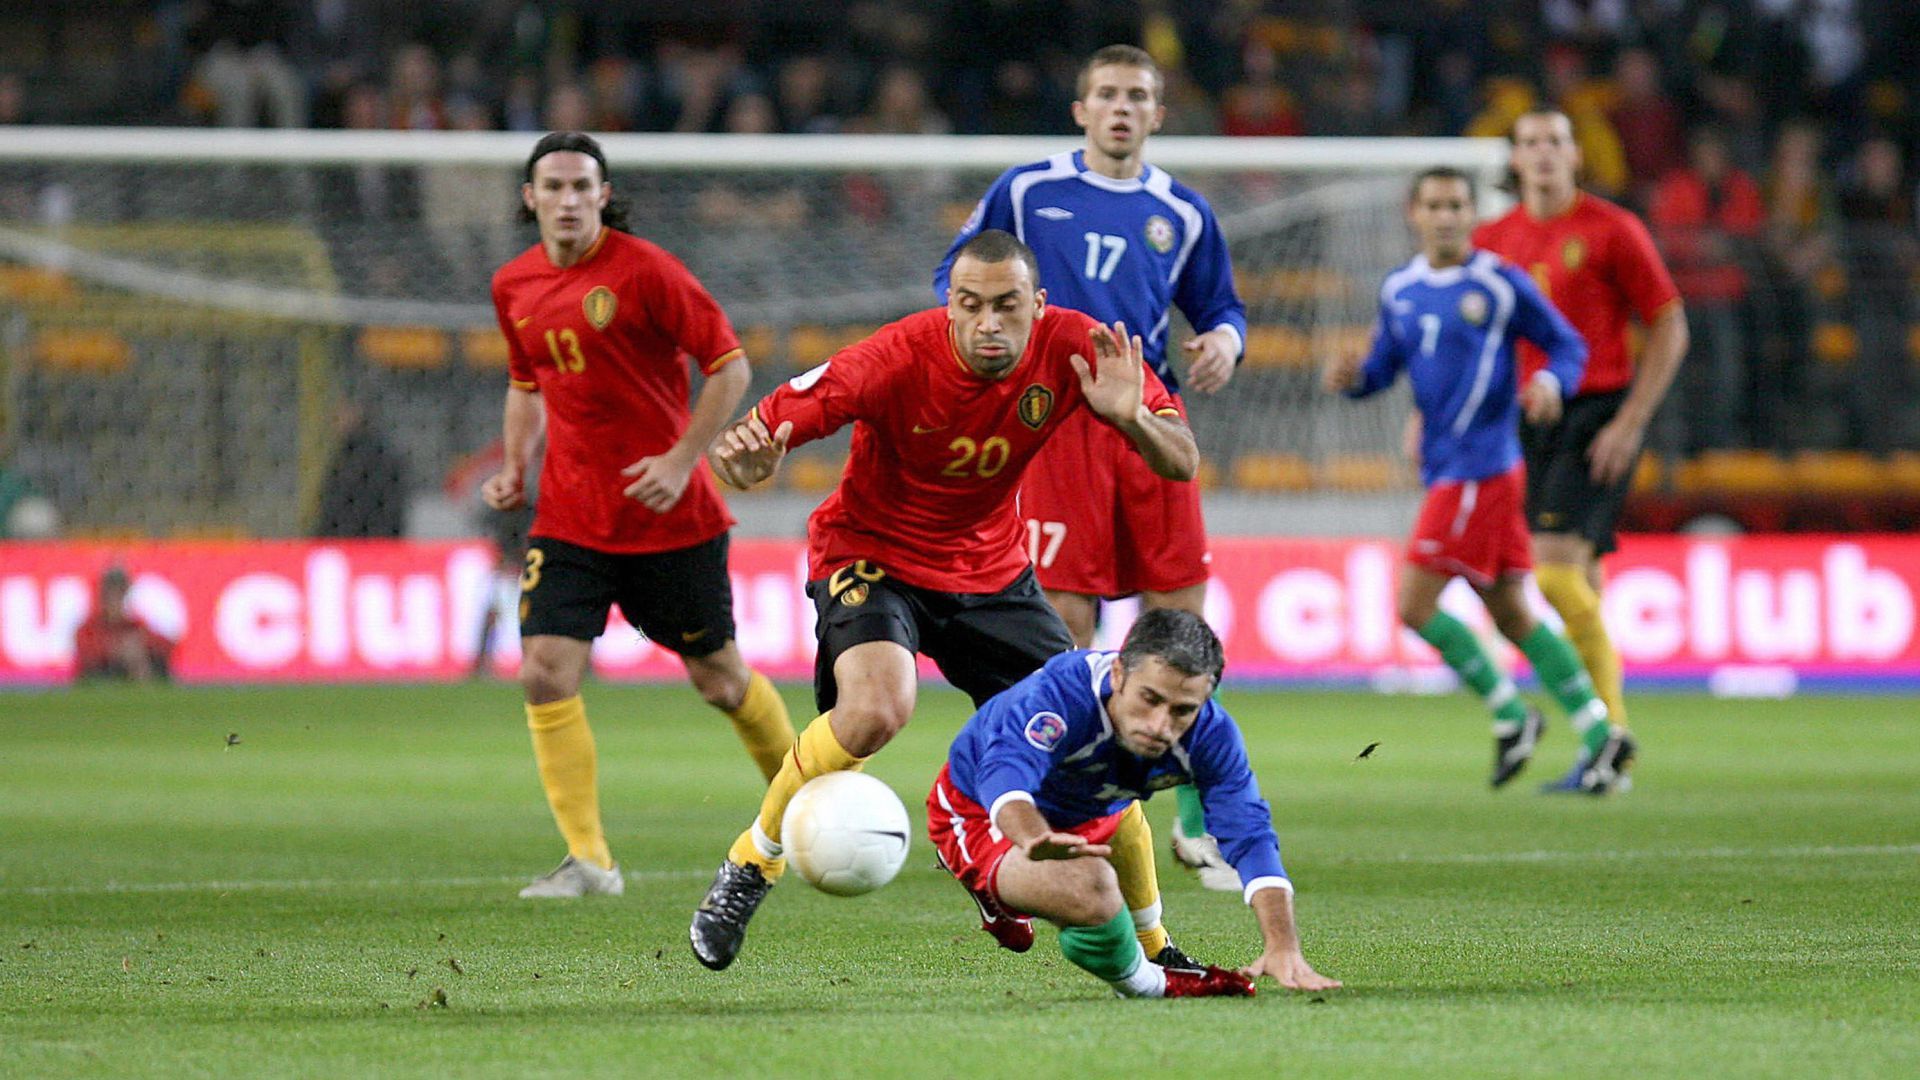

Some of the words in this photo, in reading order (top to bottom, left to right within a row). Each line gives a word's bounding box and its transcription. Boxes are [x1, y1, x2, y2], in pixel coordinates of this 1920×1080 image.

[1084, 231, 1128, 283] 17
[544, 328, 587, 374] 13
[940, 436, 1011, 478] 20
[1026, 518, 1067, 569] 17
[1603, 543, 1916, 662] club
